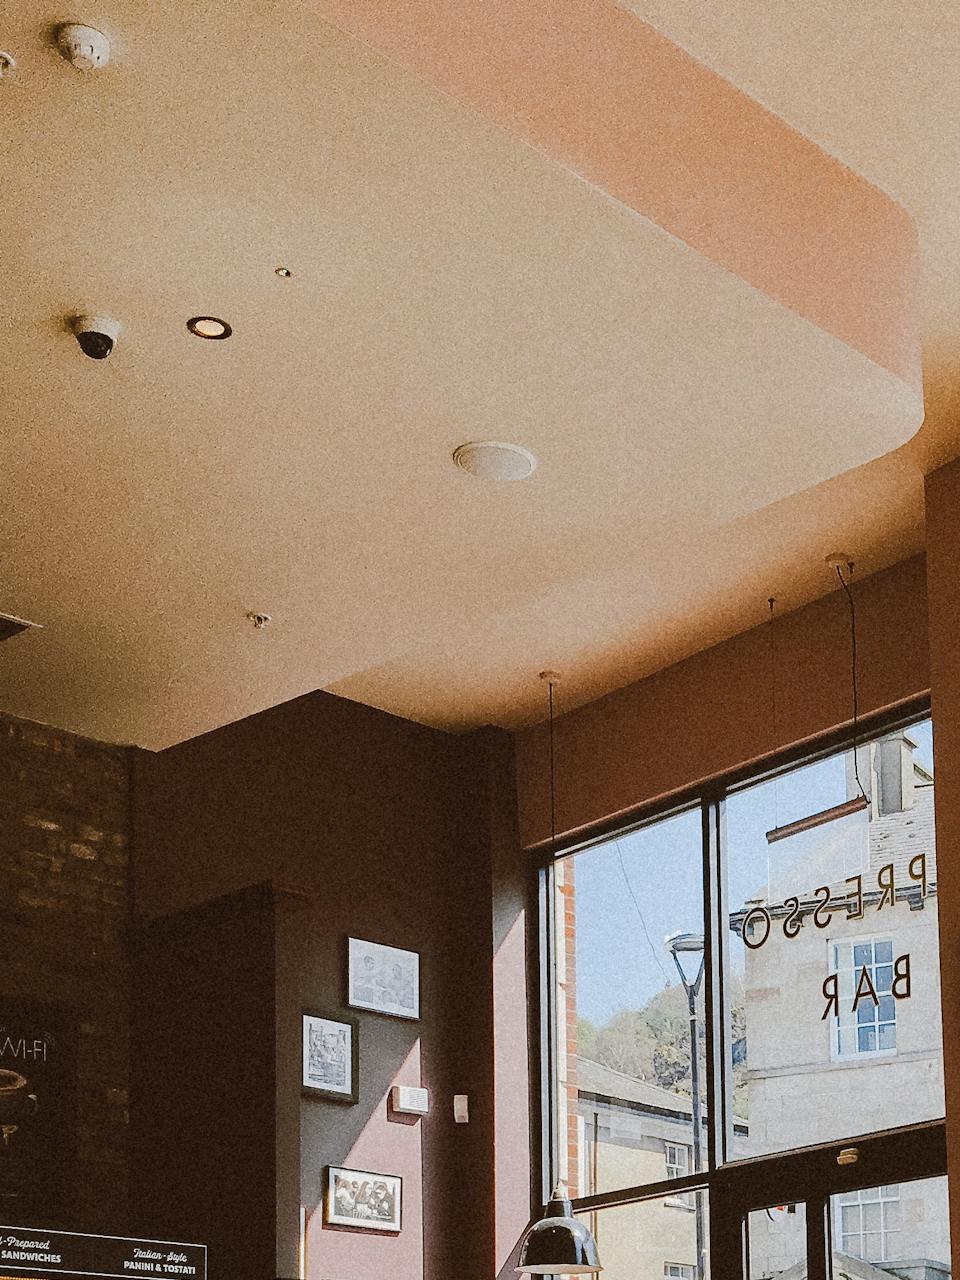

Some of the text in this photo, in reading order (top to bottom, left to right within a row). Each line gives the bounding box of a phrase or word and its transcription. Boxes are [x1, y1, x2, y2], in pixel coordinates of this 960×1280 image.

[1, 1250, 62, 1264] SANDWICHES
[123, 1260, 196, 1275] PANINI & TOSTATI
